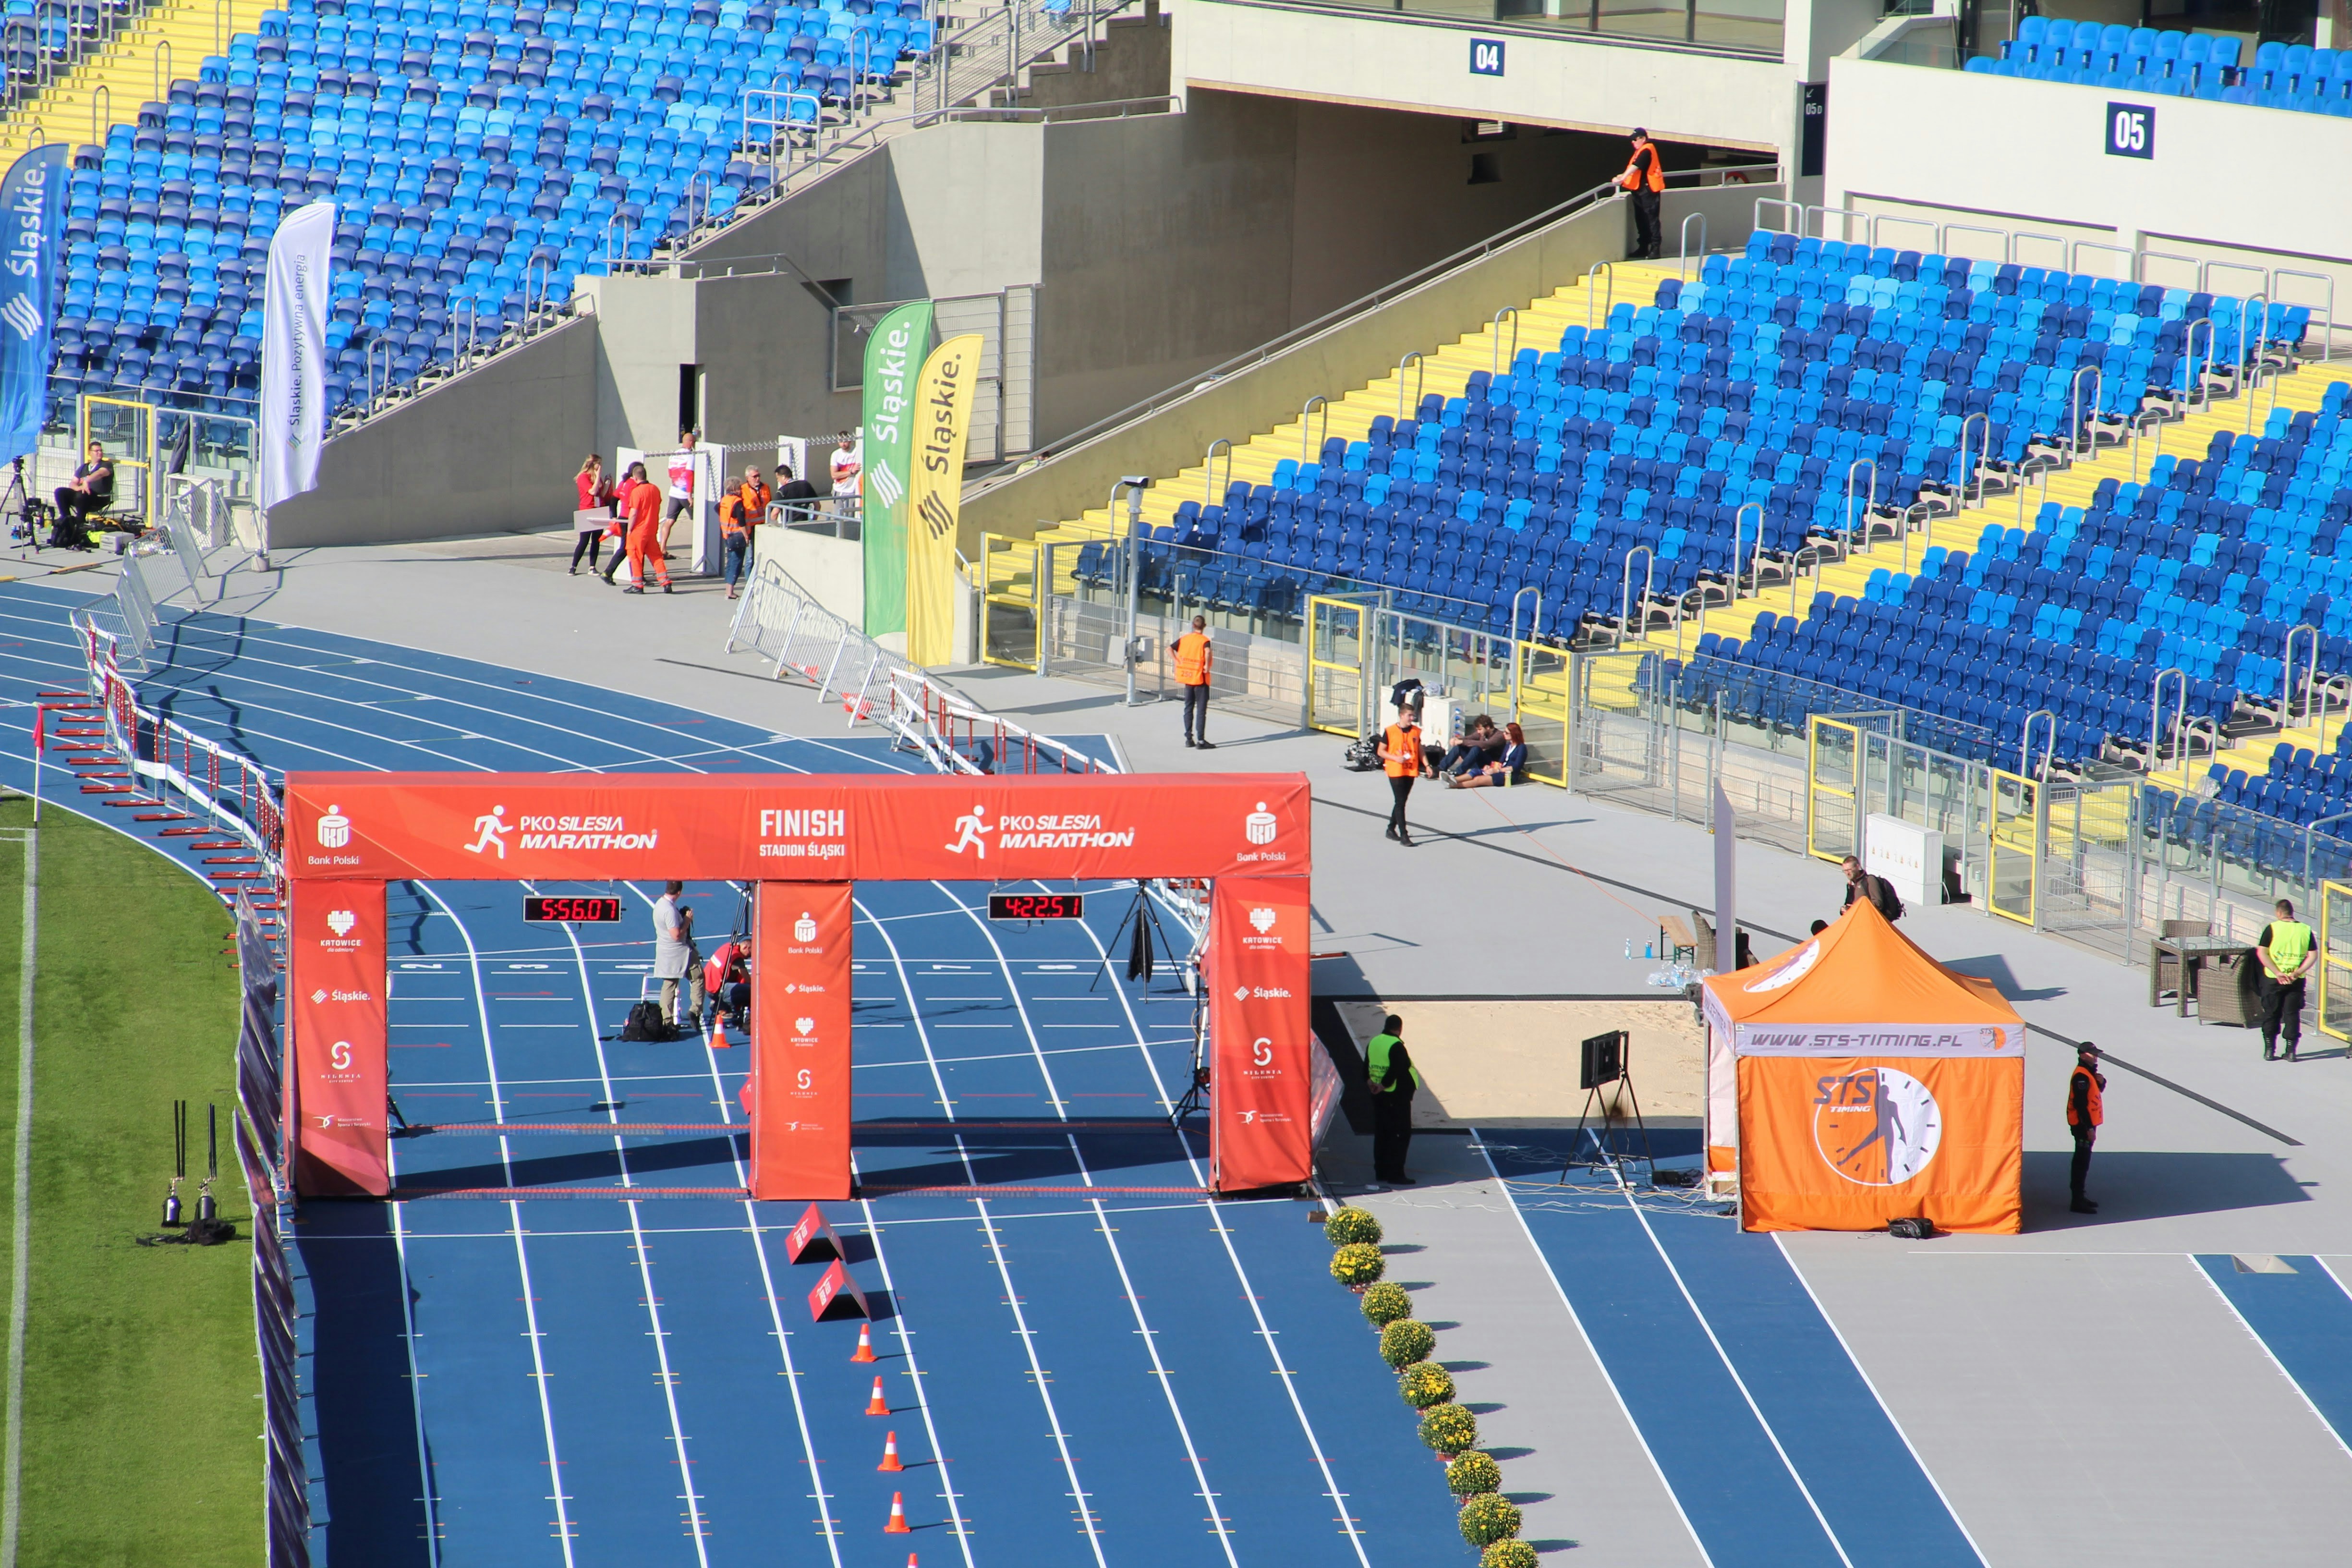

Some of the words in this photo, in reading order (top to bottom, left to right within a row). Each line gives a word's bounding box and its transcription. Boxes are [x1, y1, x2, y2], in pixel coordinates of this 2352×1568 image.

[1477, 44, 1499, 71] 04
[2115, 111, 2145, 150] 05
[5, 161, 47, 278] Śląskie.
[294, 254, 307, 300] energia
[291, 304, 306, 371] Pozytywna
[871, 321, 910, 444] Śląskie.
[287, 375, 302, 425] Śląskie.
[921, 353, 962, 475] Śląskie.
[520, 816, 556, 831] PKO
[557, 816, 623, 831] SILESIA
[761, 810, 844, 837] FINISH
[1000, 815, 1035, 831] PKO
[1036, 815, 1101, 830] SILESIA
[308, 855, 330, 864] Bank
[333, 855, 359, 865] Polski
[759, 844, 805, 857] STADION
[808, 842, 845, 860] ŚLĄSKI
[1237, 852, 1259, 862] Bank
[1261, 852, 1286, 861] Polski
[542, 899, 617, 920] 5:56.07
[1006, 897, 1079, 917] 4:22.51
[332, 989, 370, 1003] Śląskie.
[799, 984, 825, 994] Śląskie.
[1253, 986, 1291, 1000] Śląskie.
[1813, 1076, 1875, 1105] STS
